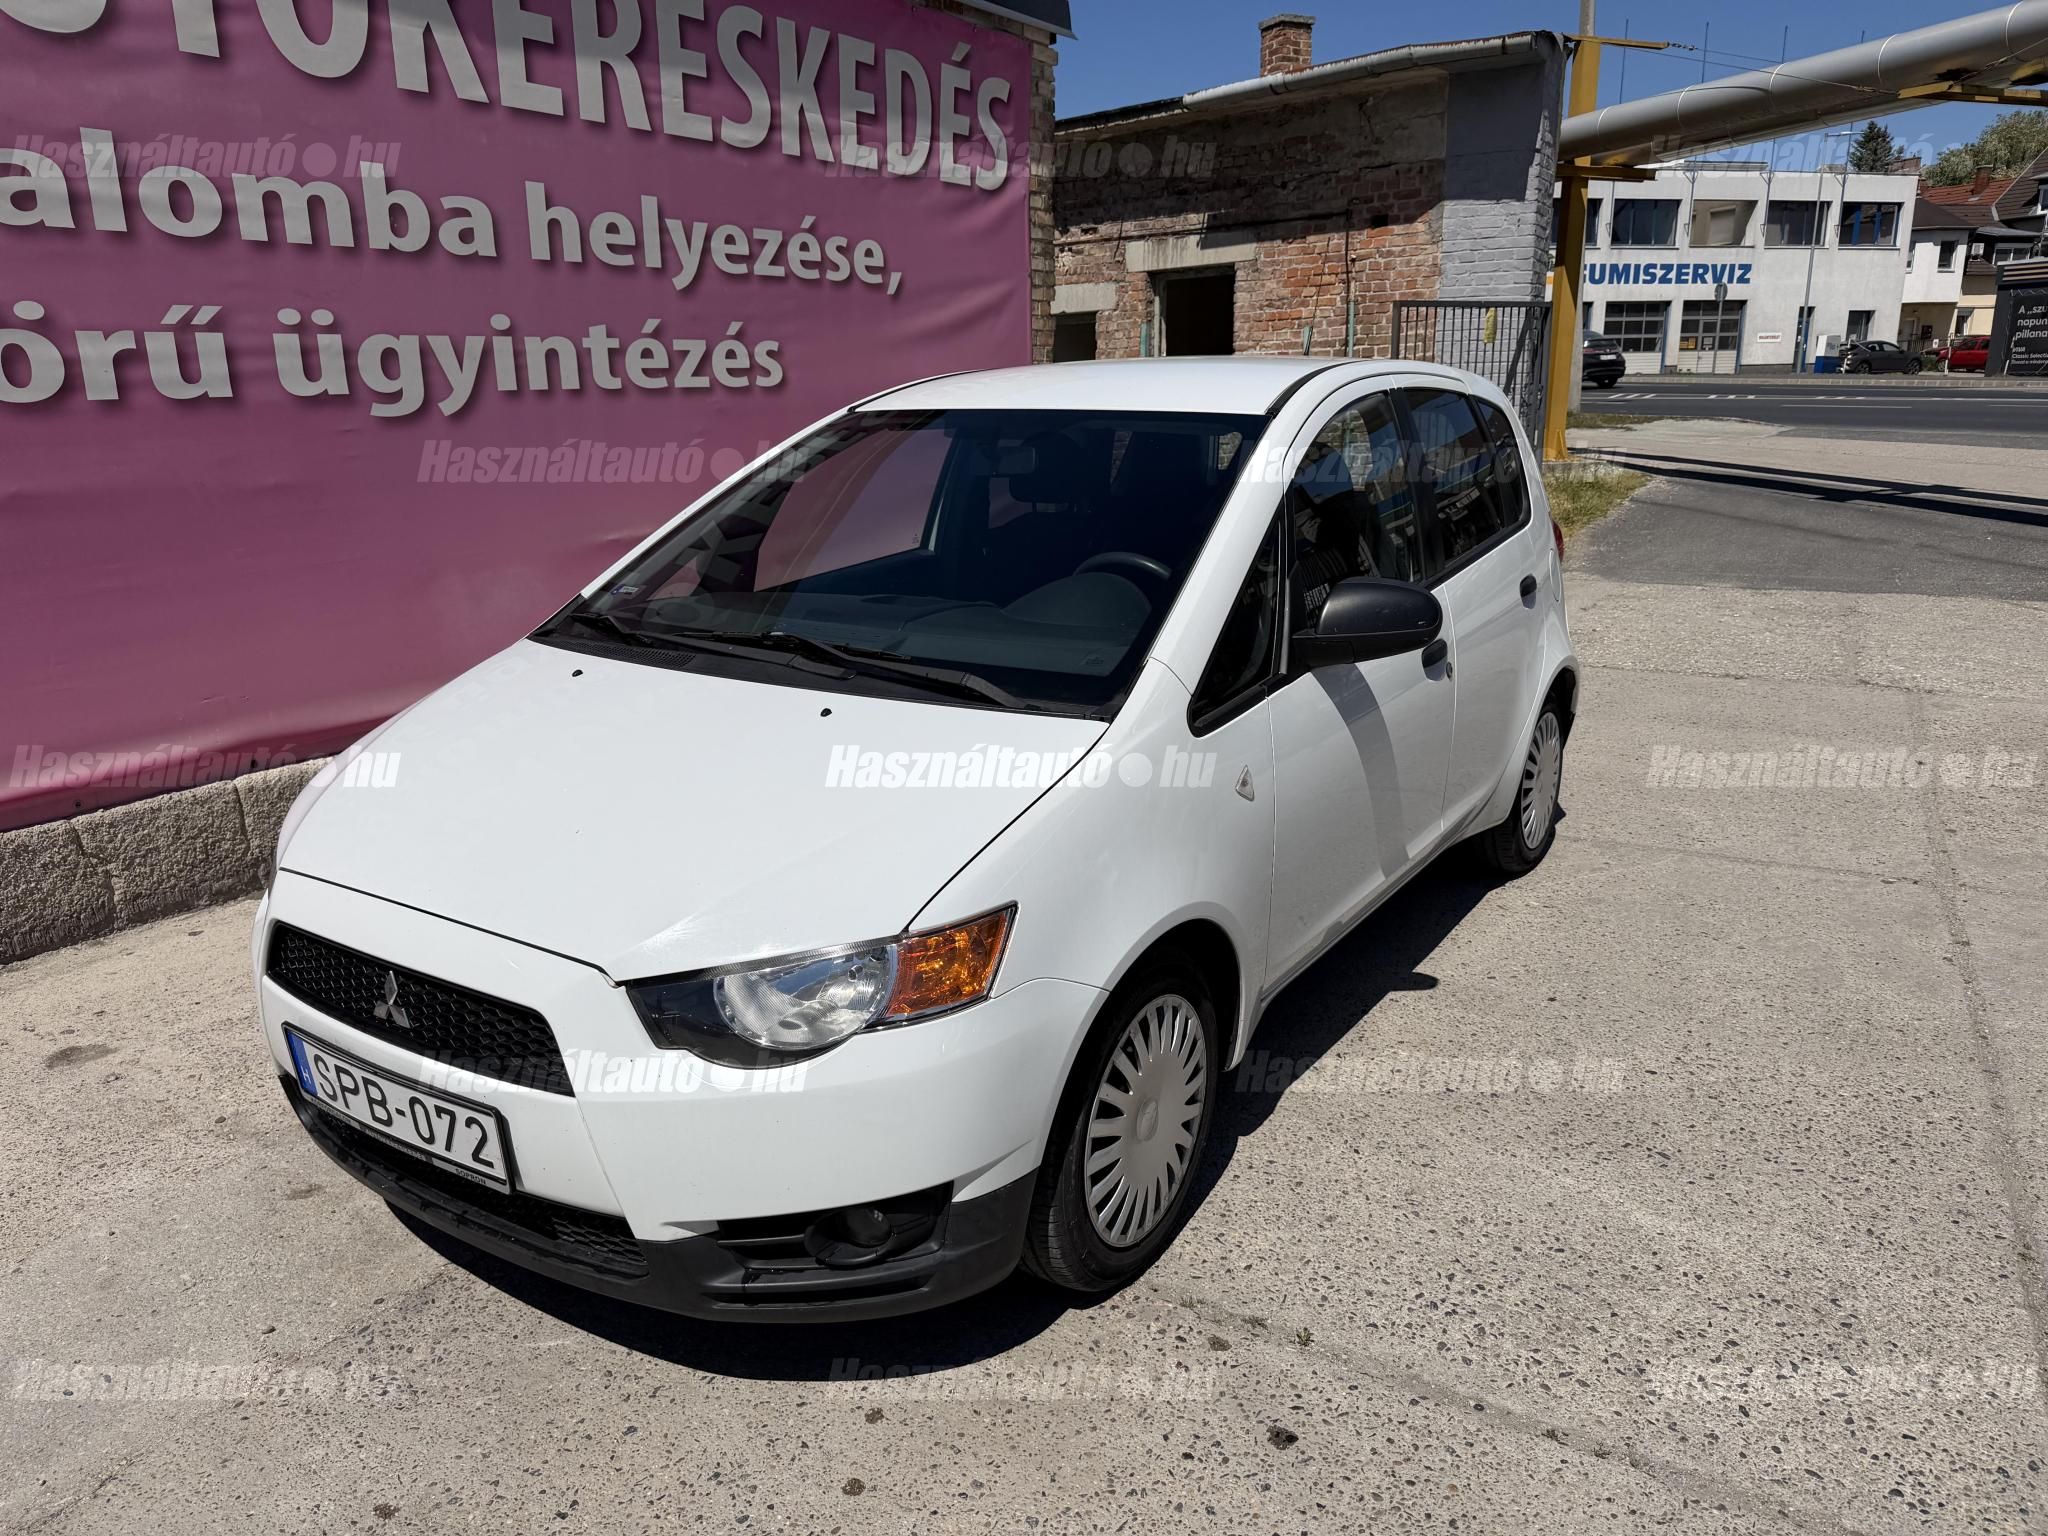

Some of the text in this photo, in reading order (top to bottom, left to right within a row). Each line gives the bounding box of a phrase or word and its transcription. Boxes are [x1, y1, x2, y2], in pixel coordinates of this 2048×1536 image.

[525, 181, 903, 295] helyezése,
[1584, 263, 1752, 285] UMISZERVIZ
[272, 308, 785, 418] ügyintézés
[314, 1054, 495, 1169] SPB-072
